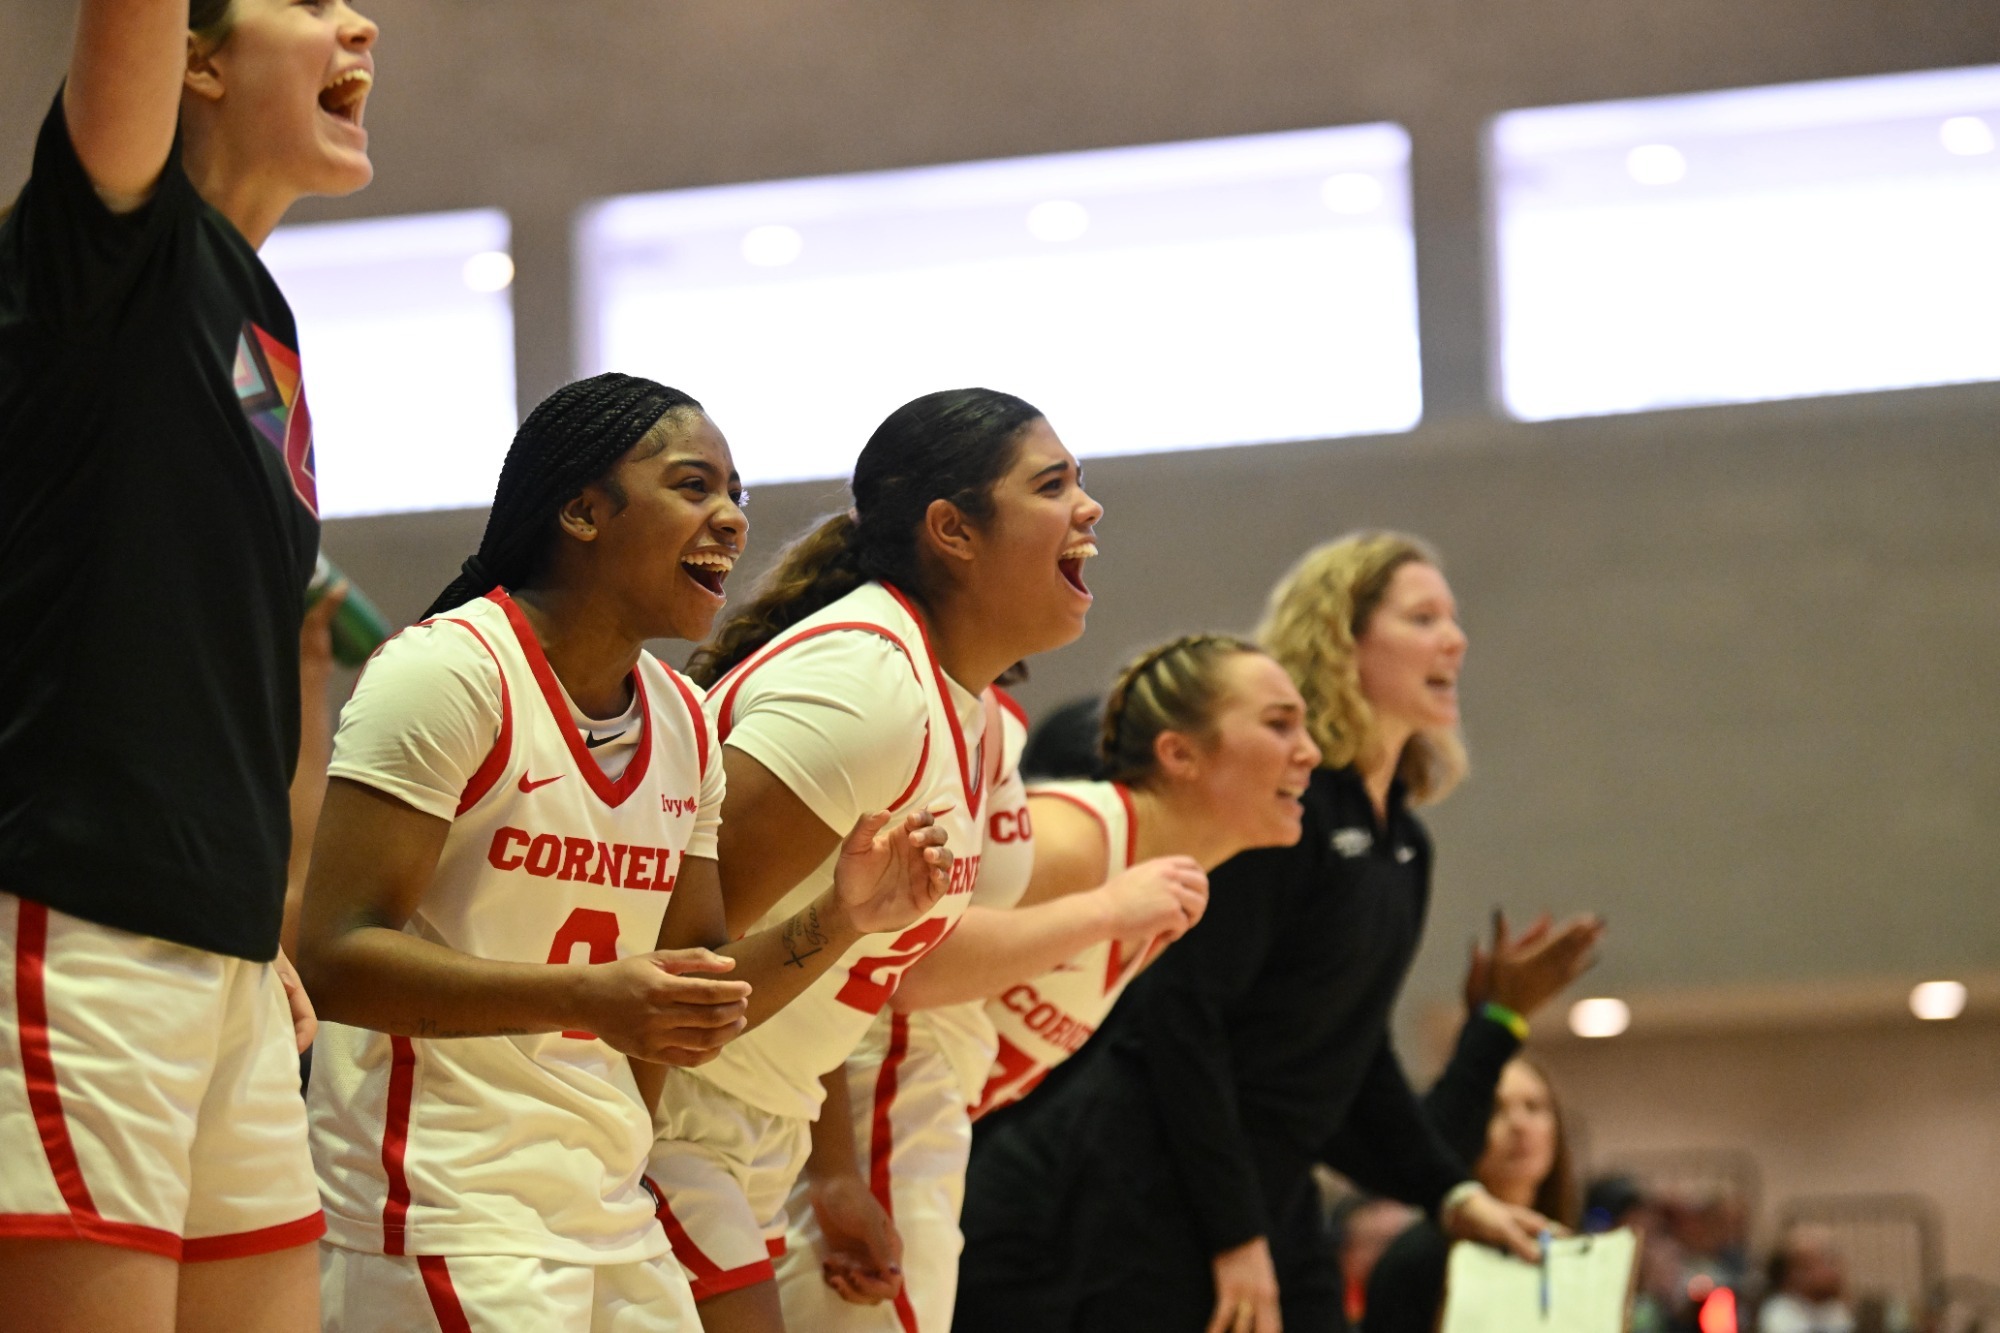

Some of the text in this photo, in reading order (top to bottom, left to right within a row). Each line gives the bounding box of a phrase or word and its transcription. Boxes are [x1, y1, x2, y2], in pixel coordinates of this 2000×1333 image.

[661, 794, 682, 818] Ivy
[488, 826, 685, 892] CORNEL
[835, 915, 963, 1016] 2
